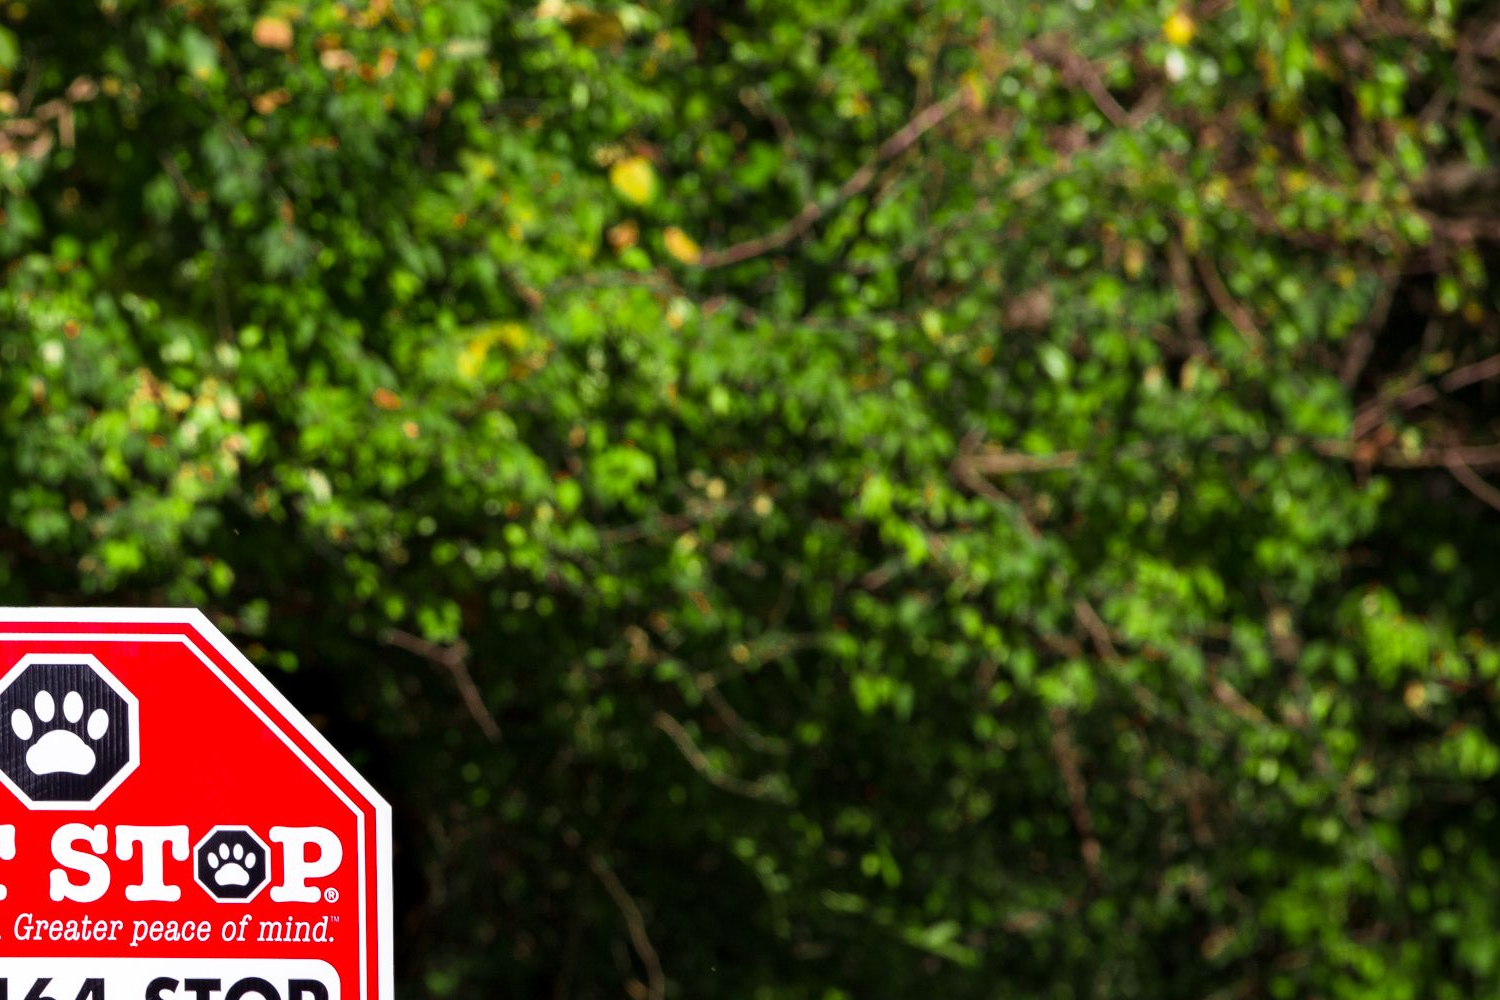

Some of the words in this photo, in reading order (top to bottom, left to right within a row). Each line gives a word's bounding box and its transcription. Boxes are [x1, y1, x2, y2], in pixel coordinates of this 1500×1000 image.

[14, 913, 123, 940] Greater
[130, 920, 211, 946] peace
[222, 914, 252, 941] of
